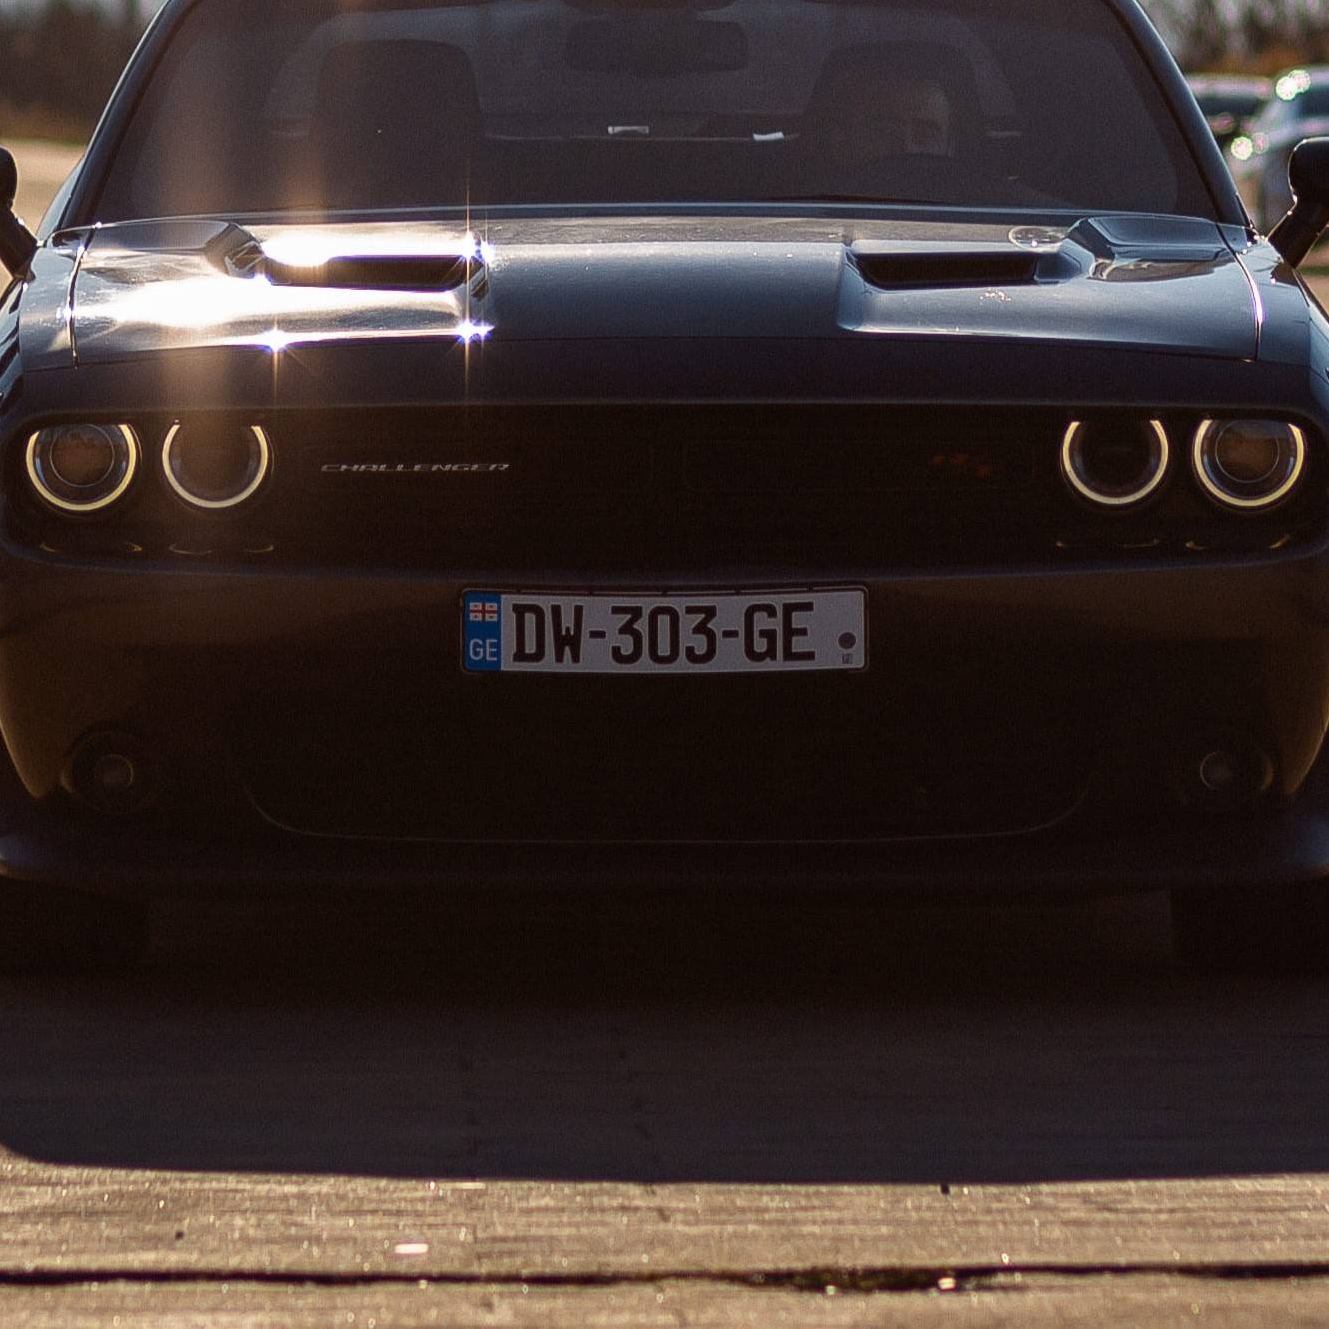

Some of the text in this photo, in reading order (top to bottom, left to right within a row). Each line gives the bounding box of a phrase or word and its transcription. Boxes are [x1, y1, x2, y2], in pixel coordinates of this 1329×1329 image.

[321, 463, 511, 472] CHALLENGER
[511, 601, 816, 666] DW-303-GE
[468, 638, 499, 662] GE
